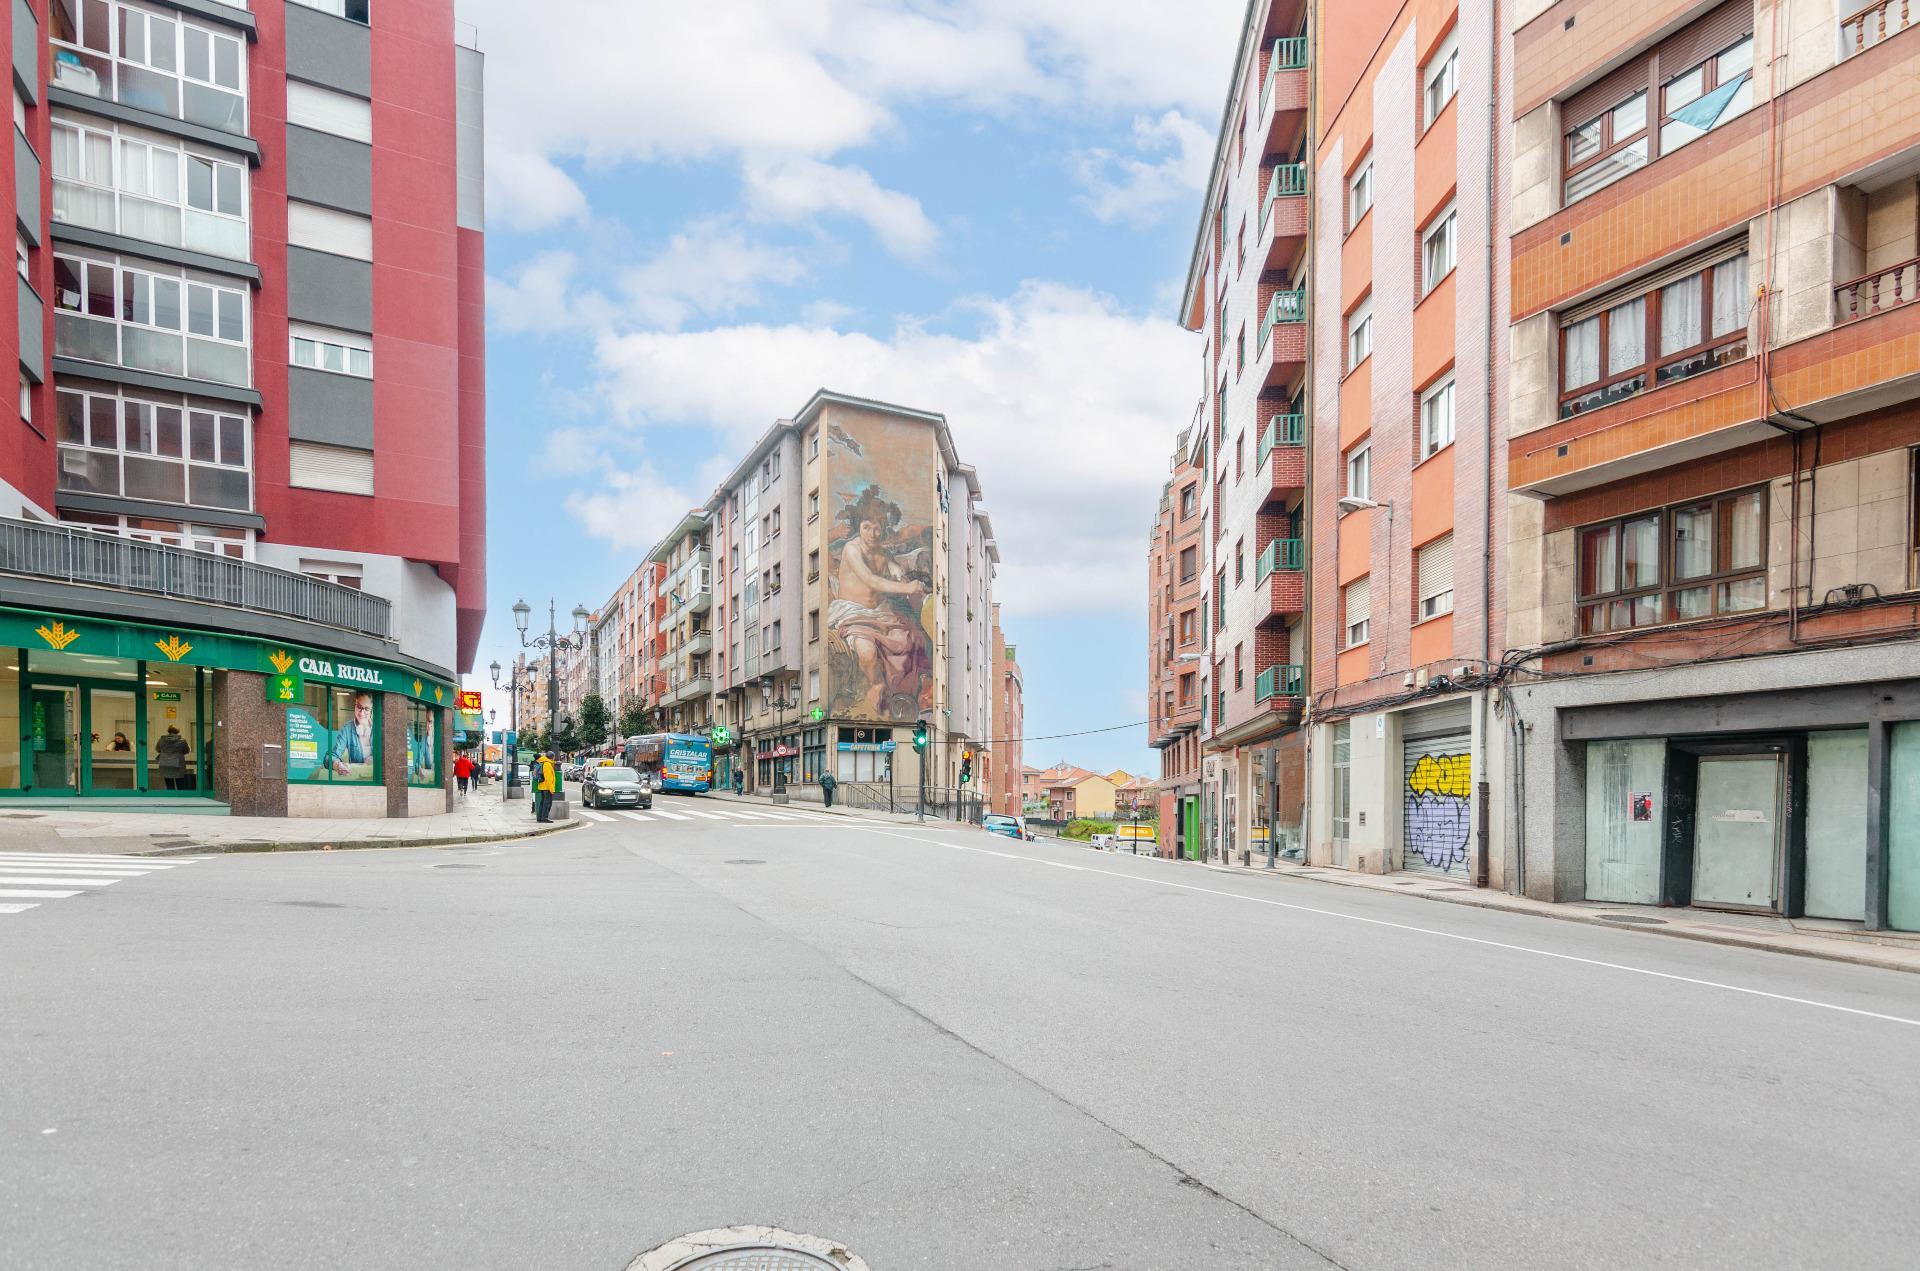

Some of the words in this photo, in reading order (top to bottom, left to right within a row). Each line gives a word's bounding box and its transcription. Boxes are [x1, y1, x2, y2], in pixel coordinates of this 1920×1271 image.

[299, 657, 334, 677] CAJA
[337, 663, 383, 685] RURAL
[280, 690, 294, 700] 24h
[670, 750, 708, 758] CRISTALAR
